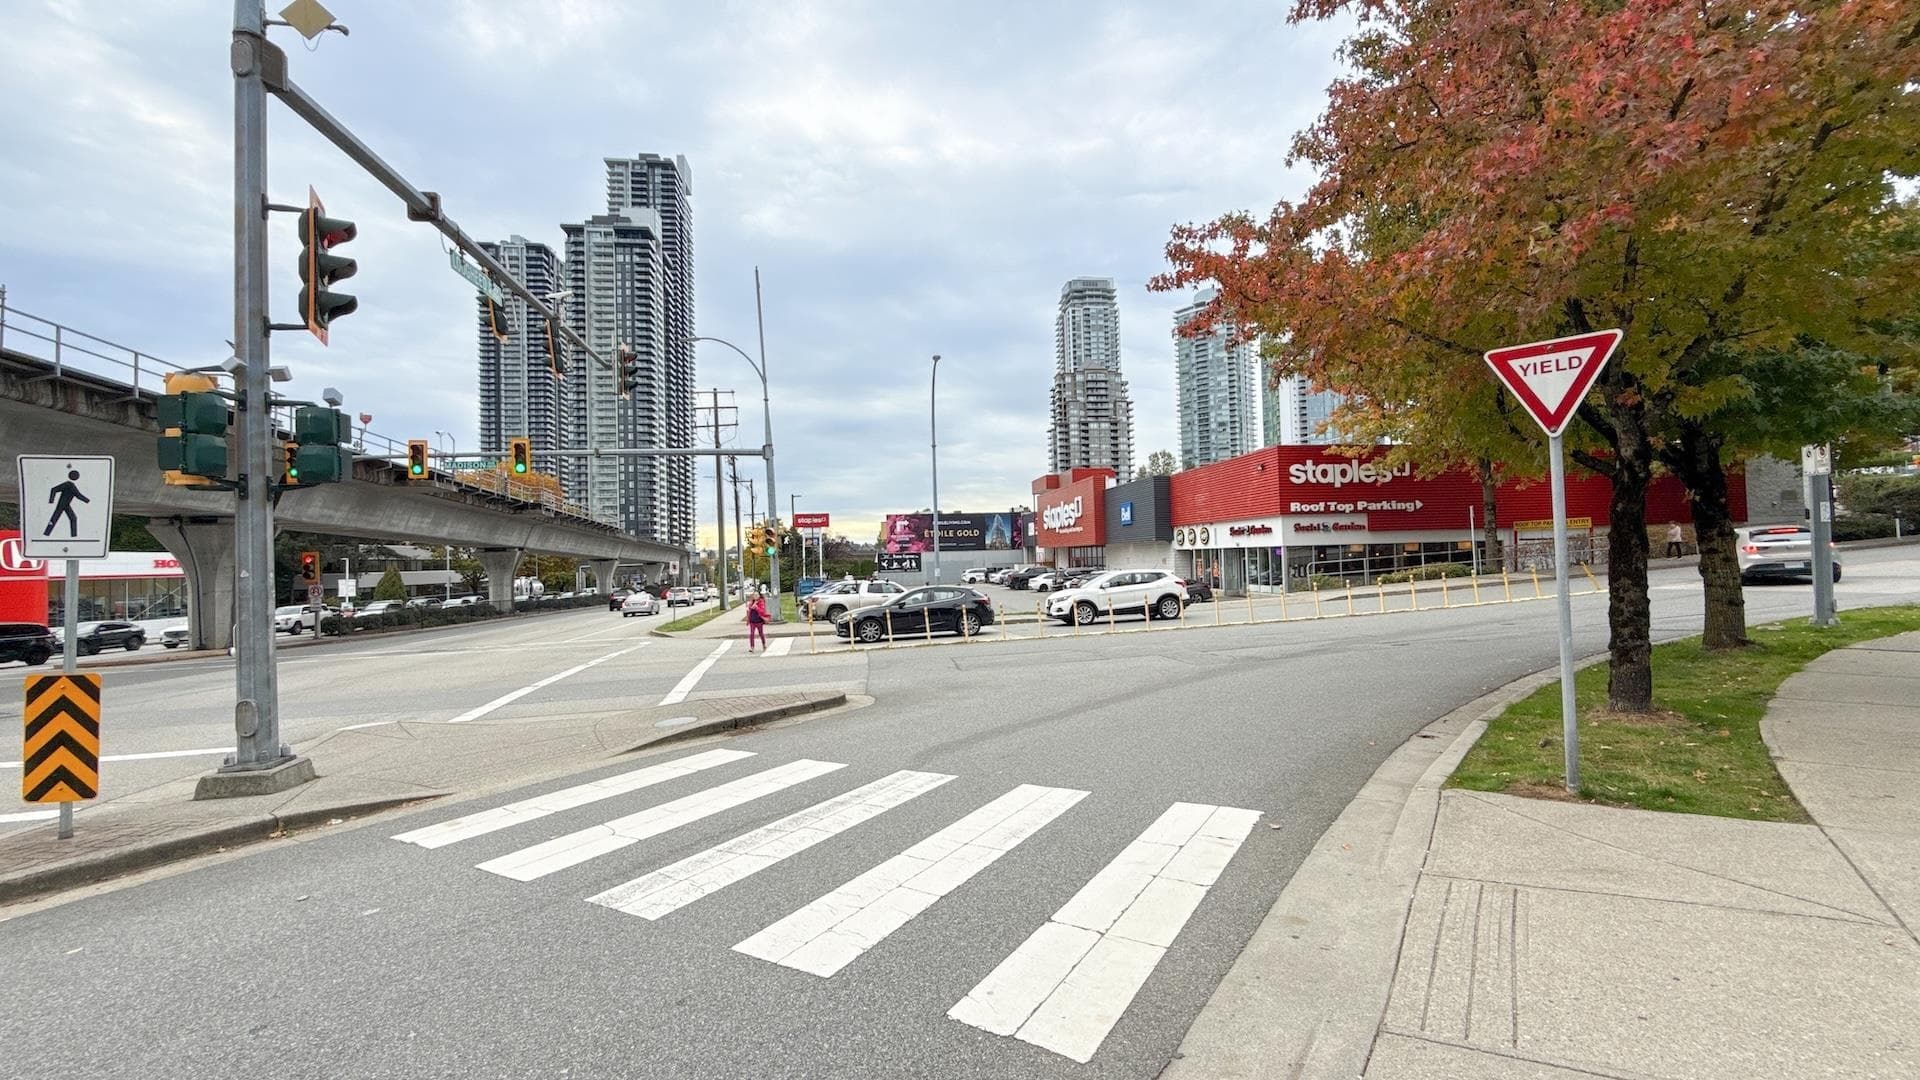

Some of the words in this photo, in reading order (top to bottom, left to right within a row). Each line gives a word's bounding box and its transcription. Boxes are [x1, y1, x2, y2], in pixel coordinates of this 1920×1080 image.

[1519, 355, 1583, 377] YIELD
[445, 461, 487, 469] MADISON
[1289, 459, 1393, 488] staples
[1289, 502, 1325, 512] Roof
[1326, 502, 1354, 513] Top
[1357, 500, 1415, 512] Parking
[1042, 500, 1075, 533] staples
[1569, 518, 1590, 526] ENTRY
[957, 529, 980, 537] GOLD
